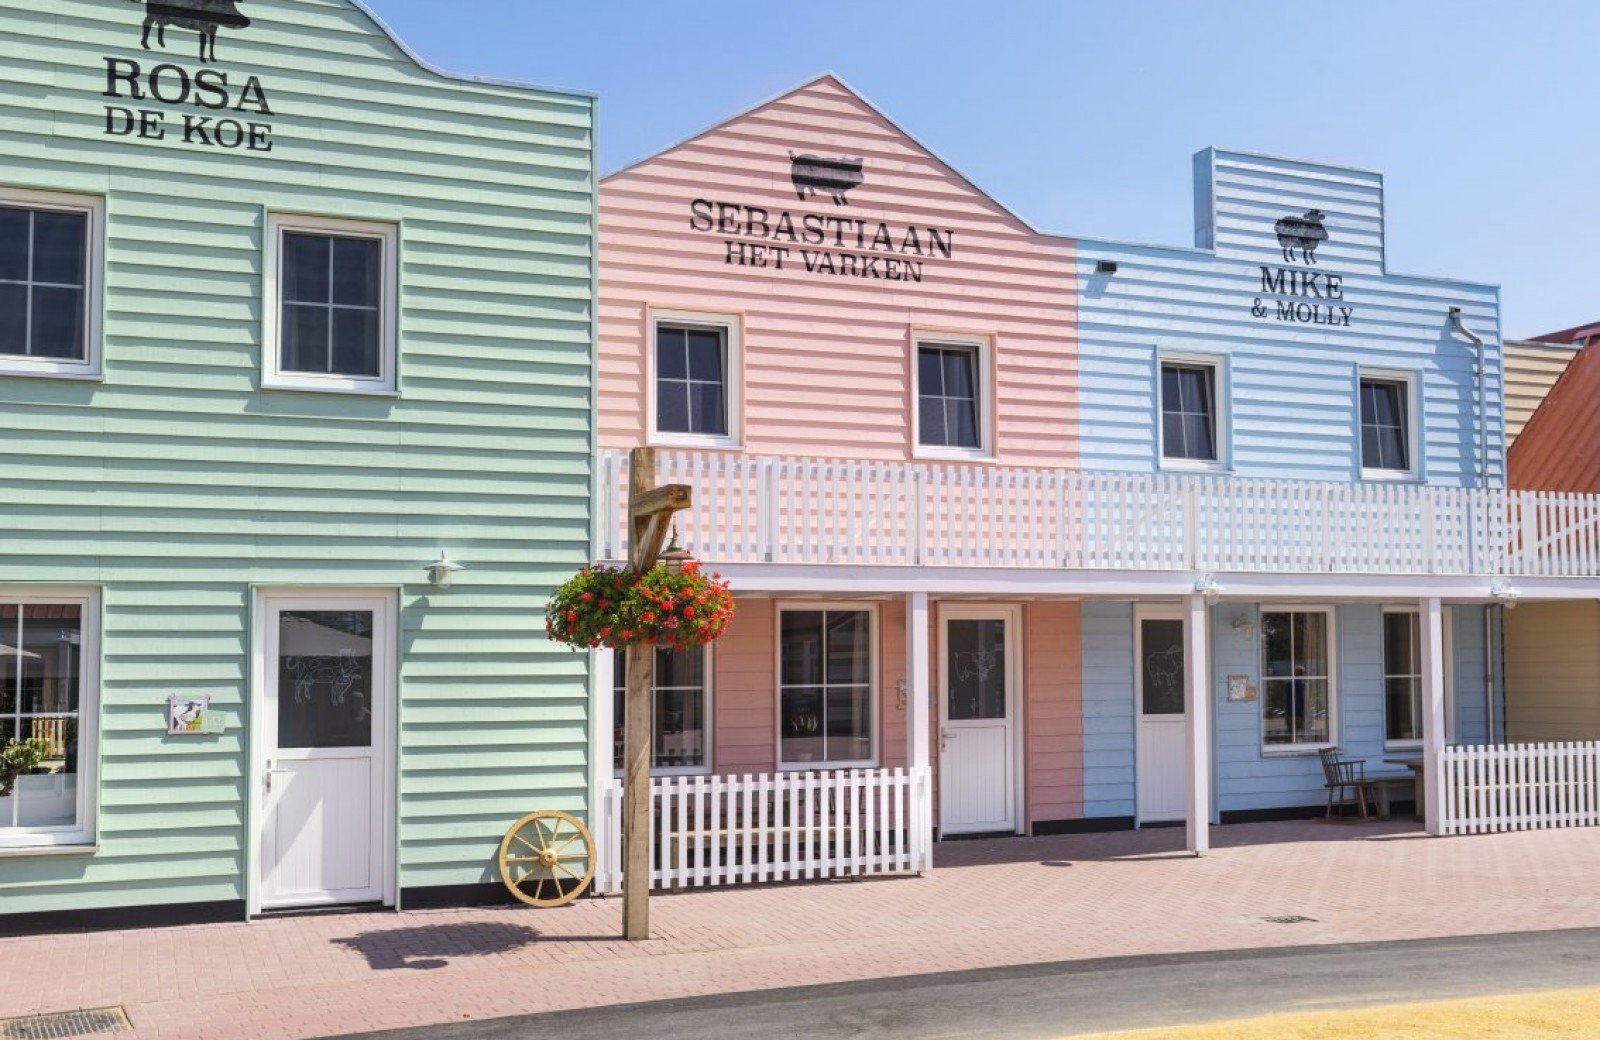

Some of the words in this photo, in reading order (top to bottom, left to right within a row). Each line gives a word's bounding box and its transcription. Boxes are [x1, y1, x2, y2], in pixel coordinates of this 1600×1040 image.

[102, 56, 275, 116] ROSA
[103, 105, 166, 141] DE
[181, 113, 273, 152] KOE
[689, 198, 955, 259] SEBASTIAAN
[724, 240, 790, 270] HET
[799, 249, 924, 283] VARKEN
[1259, 266, 1343, 301] MIKE
[1251, 297, 1268, 318] &
[1276, 299, 1354, 327] MOLLY
